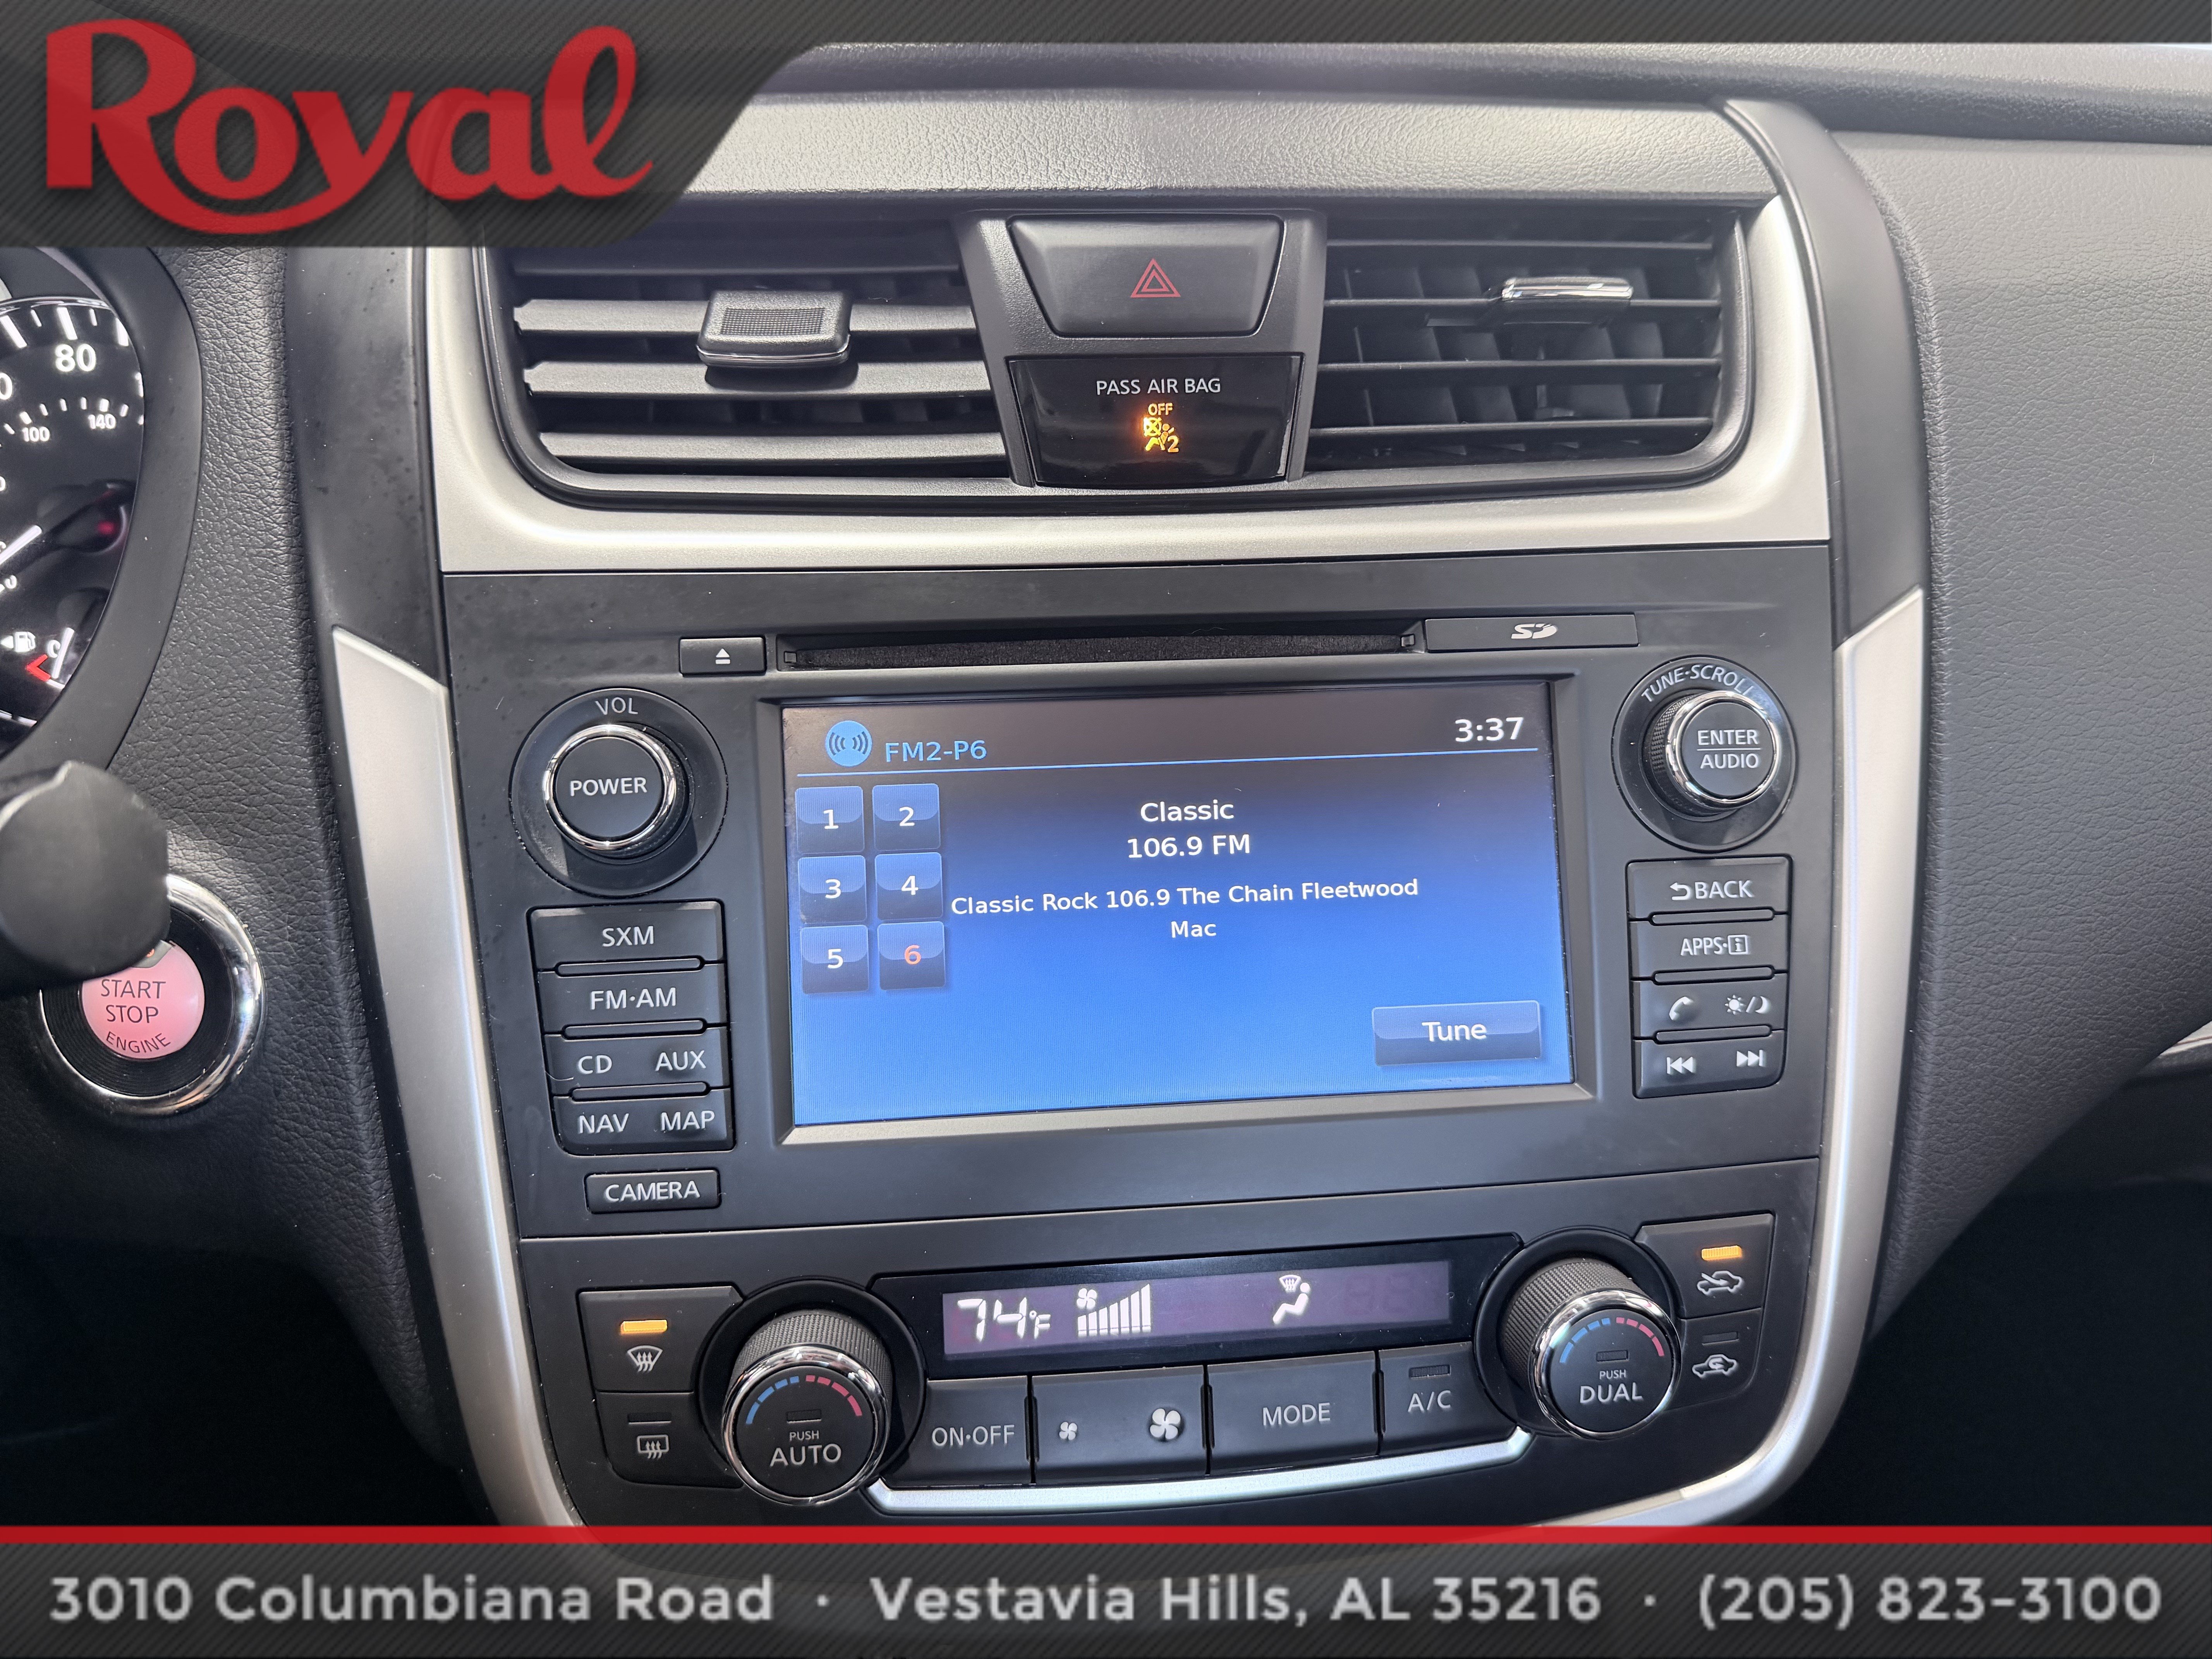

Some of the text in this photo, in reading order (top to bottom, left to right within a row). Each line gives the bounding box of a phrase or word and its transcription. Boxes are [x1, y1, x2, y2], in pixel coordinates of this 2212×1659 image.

[55, 343, 96, 372] 80
[1096, 378, 1221, 395] PASS AIR BAG
[1148, 402, 1173, 416] OFF
[88, 413, 116, 429] 140
[21, 426, 50, 442] 100
[1511, 623, 1558, 639] SD
[595, 697, 638, 715] VOL
[1455, 717, 1524, 742] 3:37
[1698, 729, 1759, 745] ENTER
[886, 740, 988, 763] FM2-P6
[1700, 753, 1759, 769] AUDIO
[570, 777, 647, 797] POWER
[823, 809, 839, 829] 1
[899, 807, 915, 826] 2
[1140, 799, 1234, 822] Classic
[1127, 834, 1250, 858] 106.9 FM
[825, 879, 841, 899] 3
[901, 876, 919, 895] 4
[1695, 880, 1753, 899] BACK
[951, 878, 1418, 915] Classic Rock 106.9 The Chain Fleetwood
[602, 926, 654, 947] SXM
[1171, 921, 1216, 938] Mac
[828, 948, 843, 969] 5
[905, 946, 921, 964] 6
[101, 978, 166, 999] START
[106, 1005, 159, 1024] STOP
[106, 1031, 171, 1053] ENGINE
[1421, 1022, 1487, 1042] Tune
[577, 1050, 706, 1074] CD AUX
[579, 1110, 715, 1133] NAV MAP
[605, 1180, 700, 1202] CAMERA
[1599, 1369, 1626, 1380] PUSH
[1408, 1390, 1451, 1413] A/C
[1580, 1382, 1643, 1404] DUAL
[1263, 1402, 1330, 1426] MODE
[789, 1430, 819, 1441] PUSH
[770, 1443, 842, 1467] AUTO
